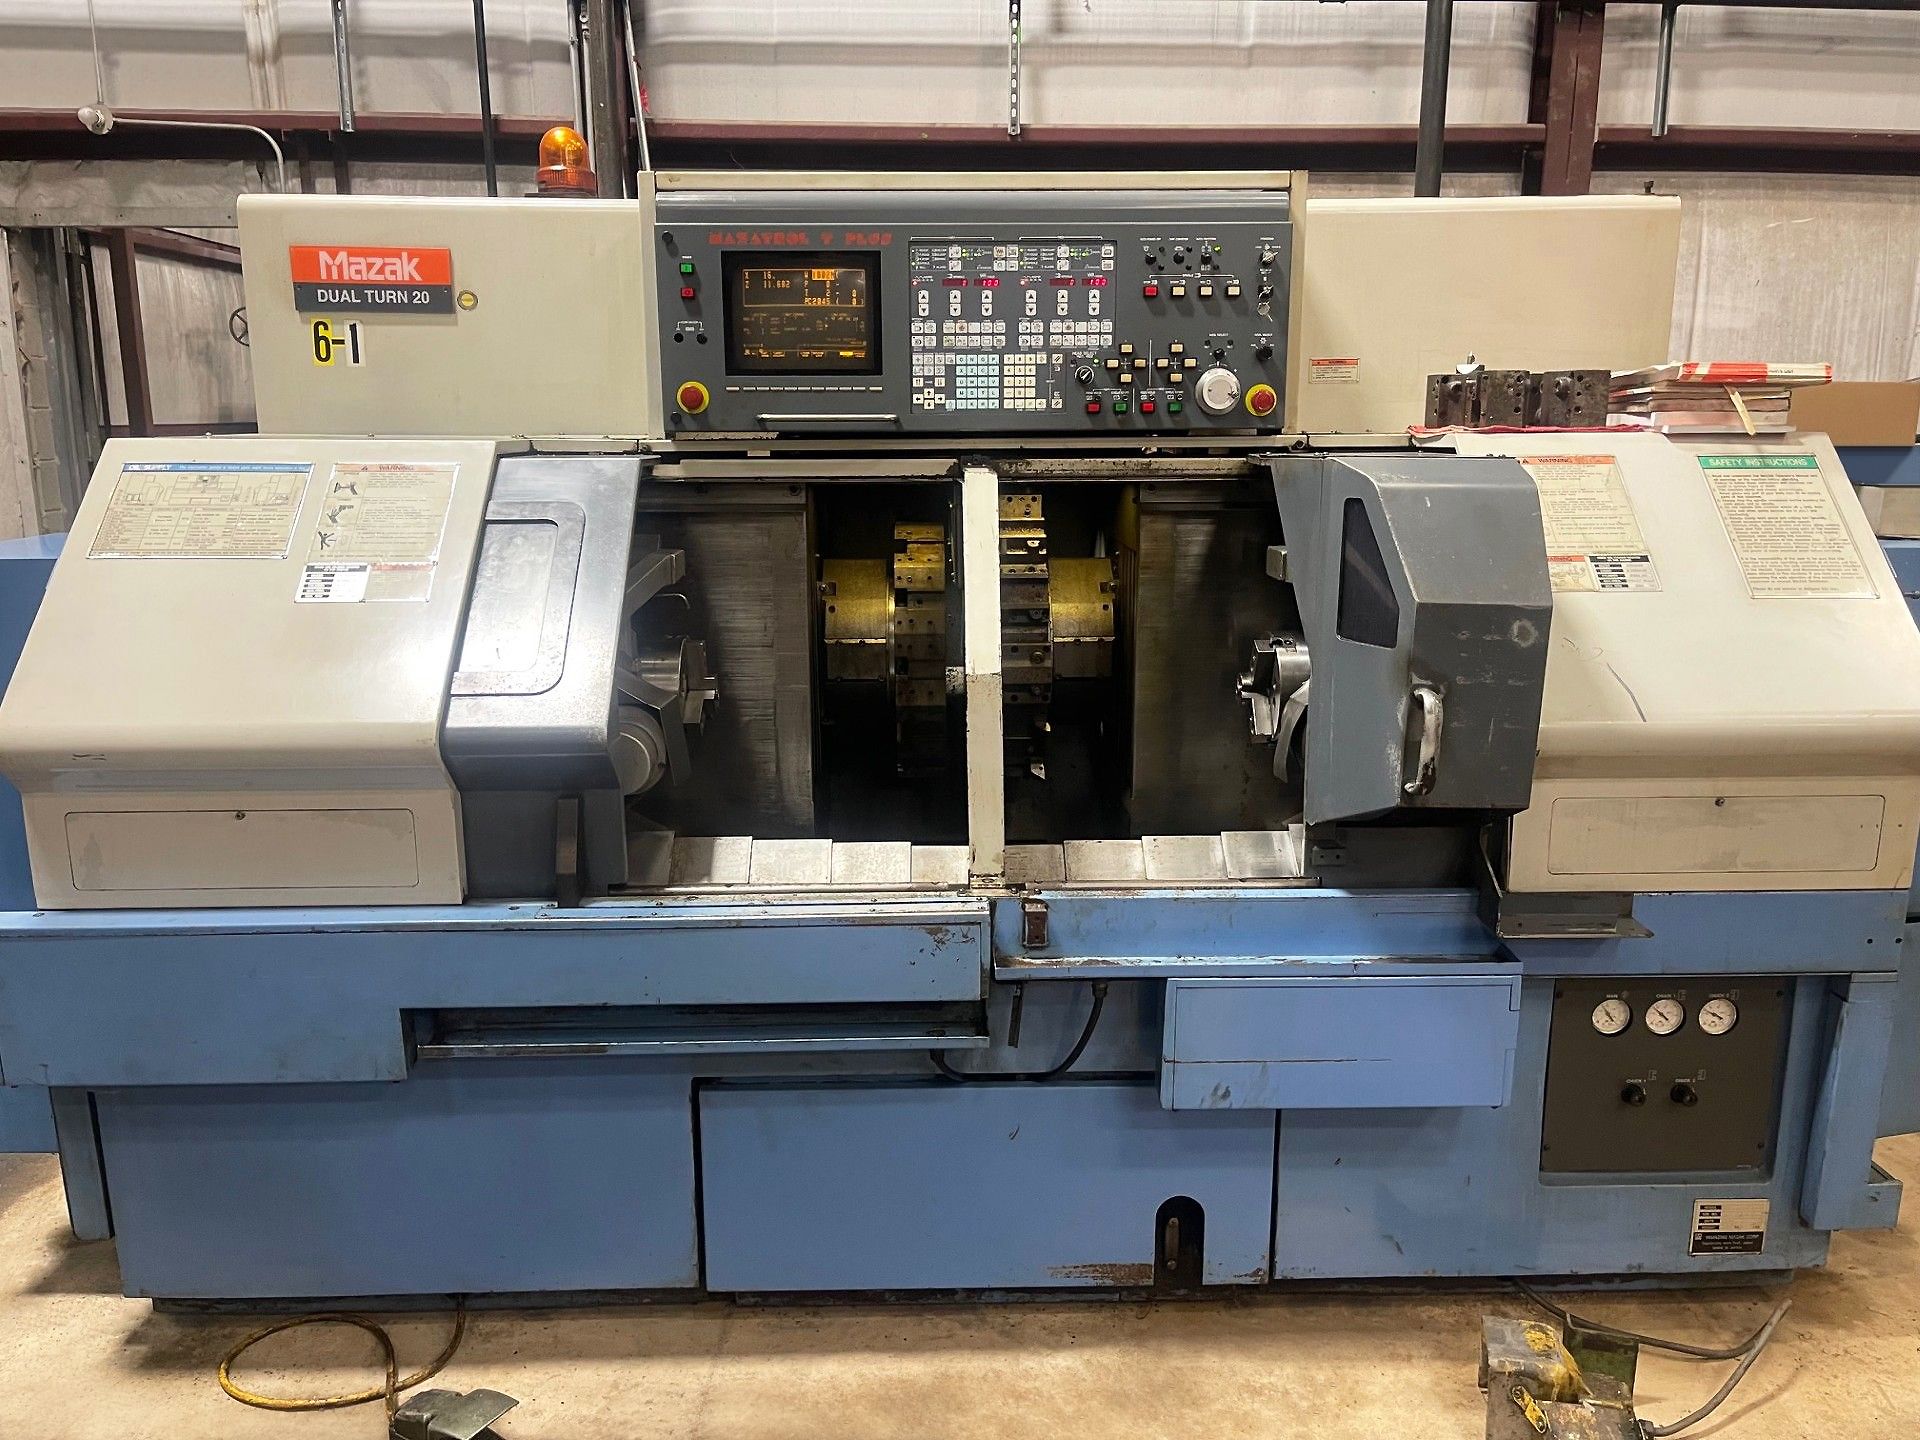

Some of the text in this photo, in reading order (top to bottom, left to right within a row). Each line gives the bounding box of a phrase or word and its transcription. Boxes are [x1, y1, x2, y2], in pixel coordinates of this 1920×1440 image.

[845, 231, 893, 245] PLUS
[318, 251, 422, 281] Mazak
[317, 289, 430, 304] DUAL TURN 20
[313, 321, 360, 364] 6-1
[1709, 458, 1809, 467] SAFETY INSTRUCTIONS
